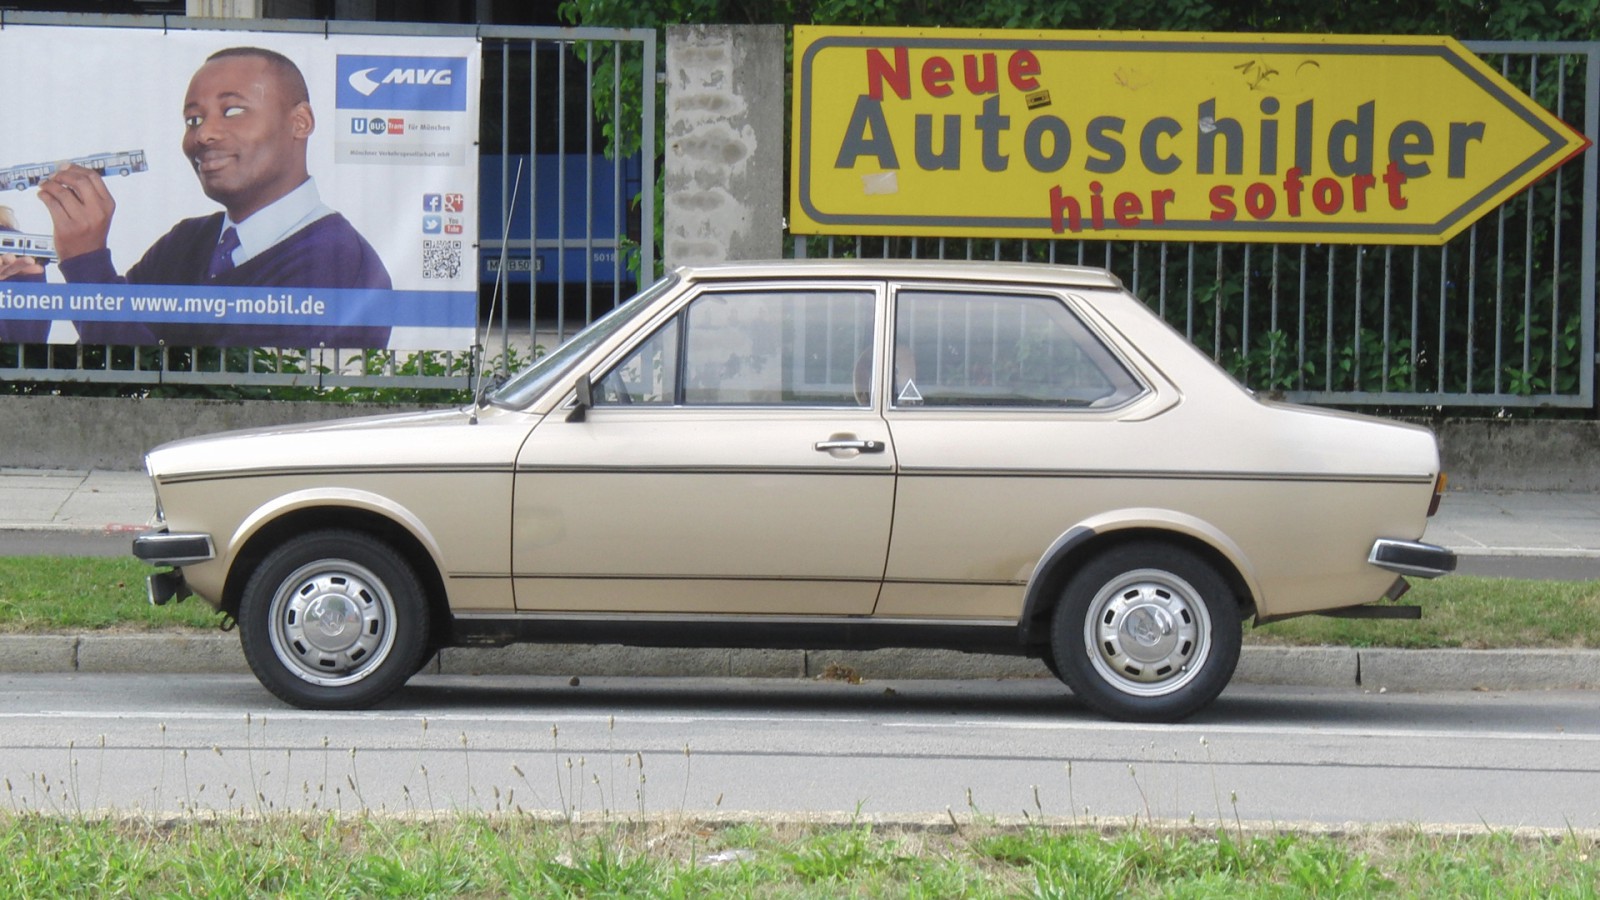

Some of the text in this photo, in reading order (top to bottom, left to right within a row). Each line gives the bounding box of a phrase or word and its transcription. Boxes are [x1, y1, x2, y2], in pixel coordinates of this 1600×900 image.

[381, 68, 452, 85] MVG
[866, 46, 1042, 101] Neue
[354, 119, 365, 132] U
[370, 122, 386, 130] BUS
[834, 94, 1486, 179] Autoschilder
[1049, 160, 1409, 234] hier sofort
[0, 289, 325, 318] tionen unter www.mvg-mobil.de
